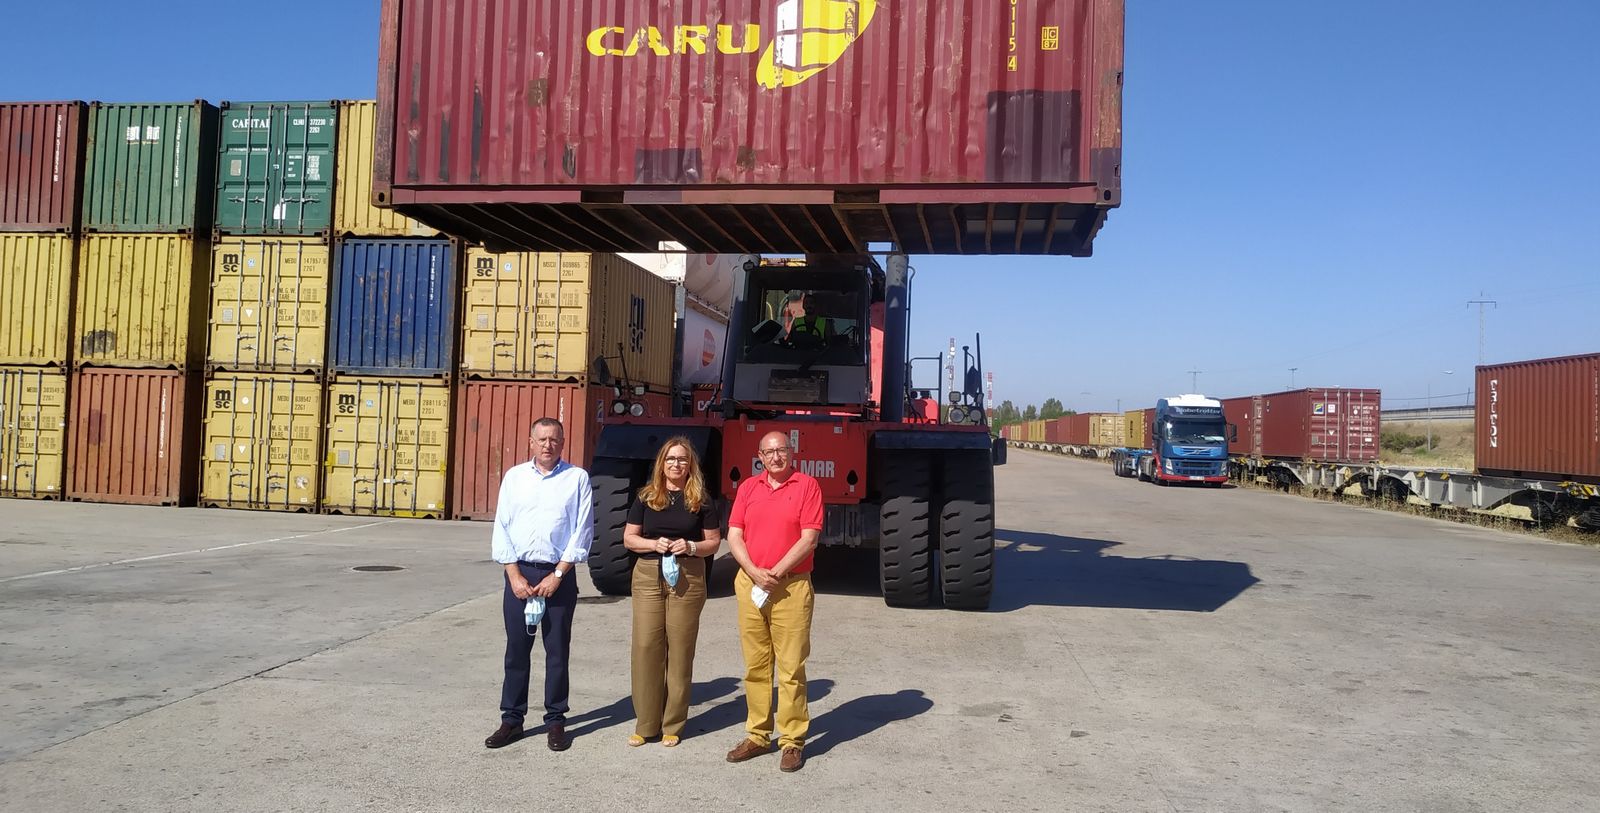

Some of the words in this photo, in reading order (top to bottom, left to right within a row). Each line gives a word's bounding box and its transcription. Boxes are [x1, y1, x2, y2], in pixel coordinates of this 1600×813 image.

[586, 24, 760, 56] CARU
[1043, 40, 1056, 48] 87
[1009, 57, 1017, 70] 4
